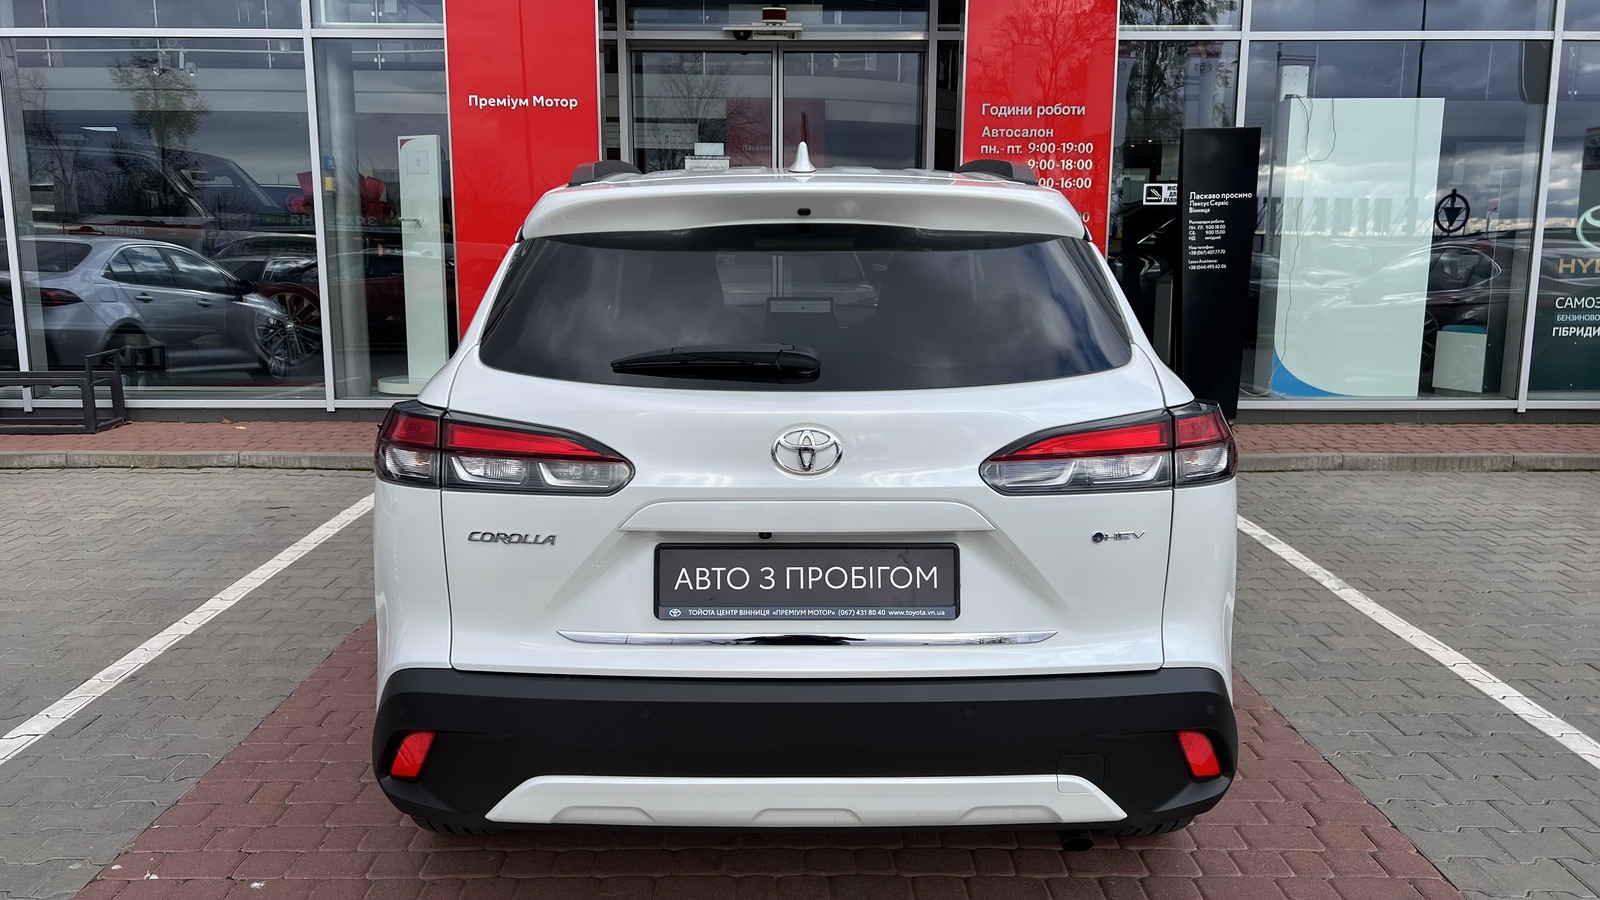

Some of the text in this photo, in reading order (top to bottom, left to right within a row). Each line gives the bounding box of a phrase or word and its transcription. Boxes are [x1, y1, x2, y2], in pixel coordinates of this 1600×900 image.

[468, 95, 578, 110] Преміум Мотор
[981, 103, 1086, 118] Години роботи
[981, 126, 1054, 138] Автосалон
[1028, 142, 1094, 154] 9:00-19:00
[1027, 159, 1093, 171] 9:00-18:00
[1189, 191, 1253, 200] Ласкаво просимо
[1189, 199, 1229, 208] Лексус Сервіс
[468, 531, 557, 545] COROLLA
[674, 566, 938, 590] АВТО З ПРОБІГОМ
[716, 609, 738, 617] ЦЕНТР
[739, 609, 770, 617] ВІННИЦЯ
[838, 609, 855, 617] (067)
[888, 609, 945, 617] www.toyota.vn.ua
